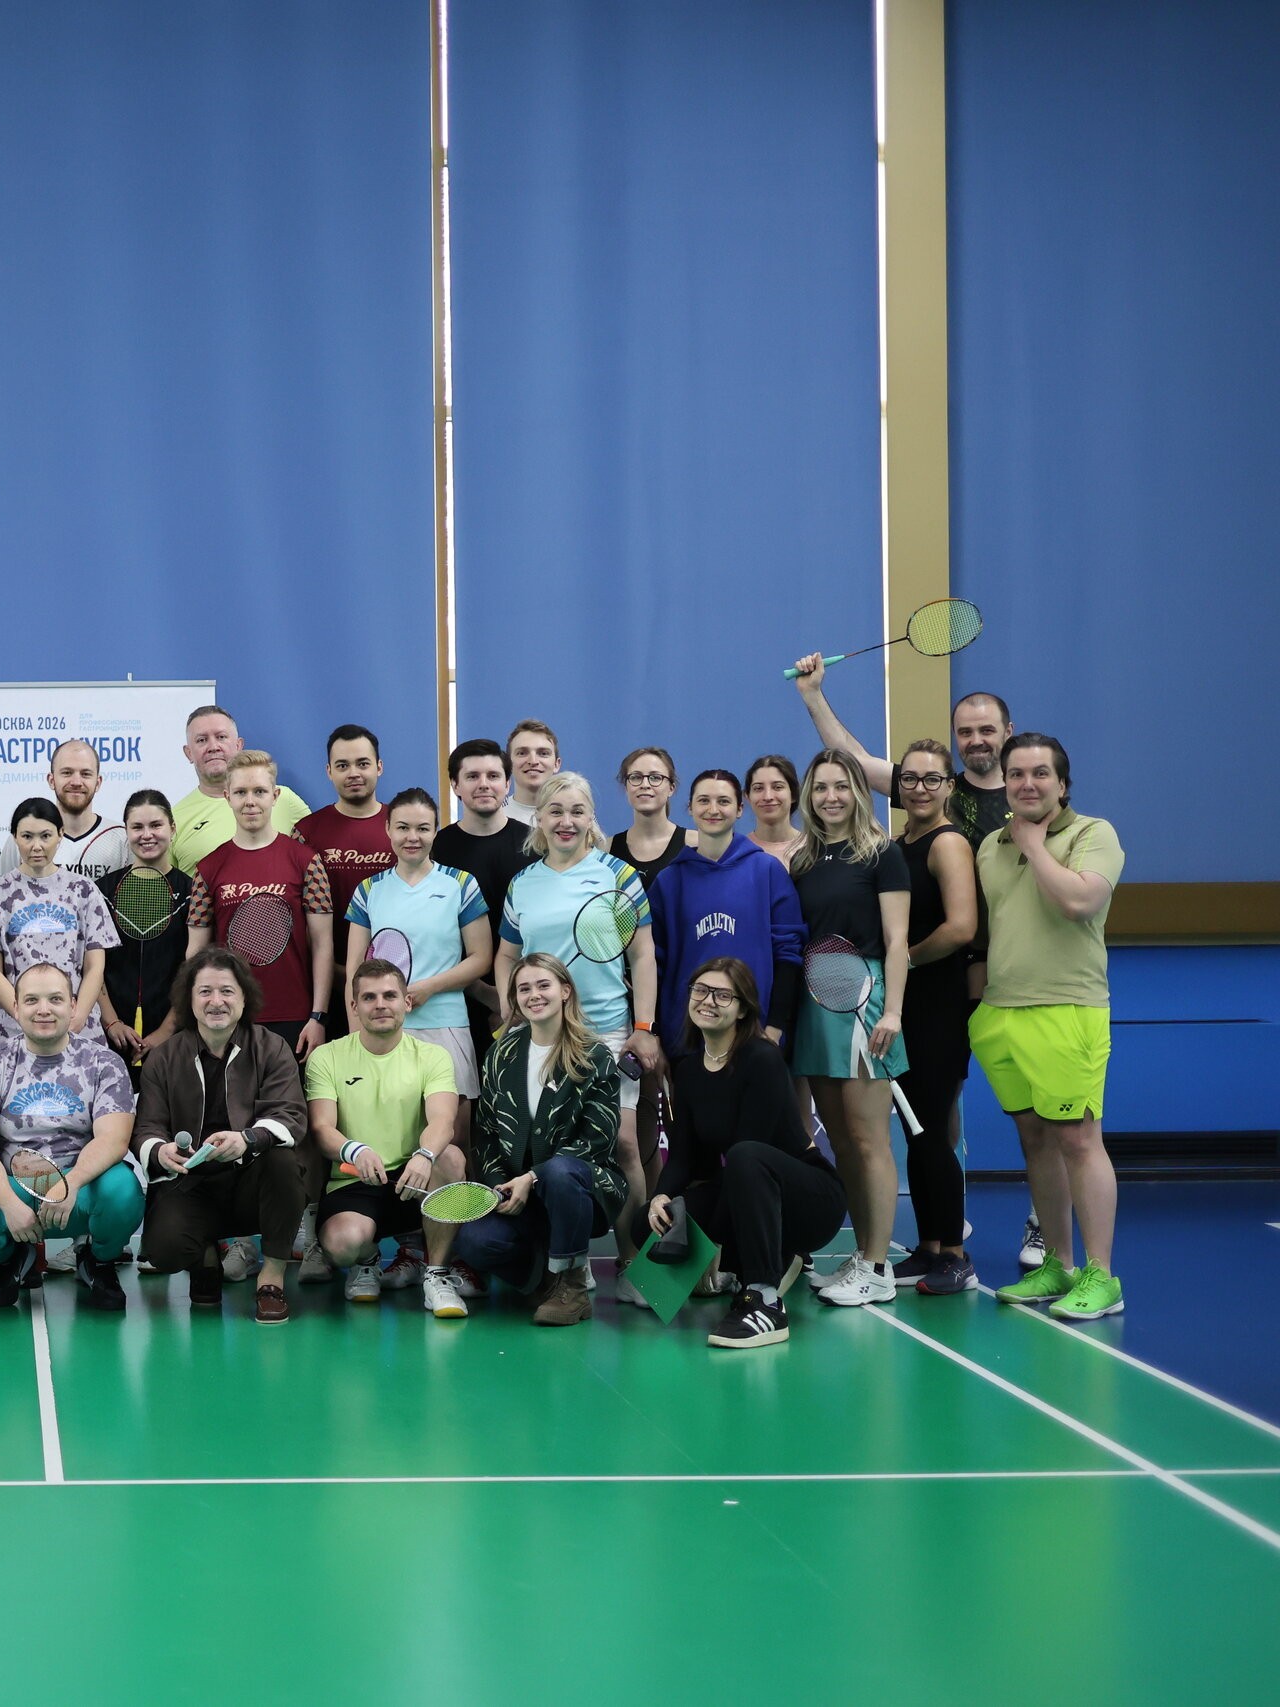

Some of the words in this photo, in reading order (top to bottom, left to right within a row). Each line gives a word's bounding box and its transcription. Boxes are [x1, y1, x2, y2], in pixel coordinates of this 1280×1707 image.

[37, 716, 66, 730] 2026
[71, 736, 142, 762] УБОК
[344, 849, 392, 864] Poetti
[238, 882, 287, 897] Poetti
